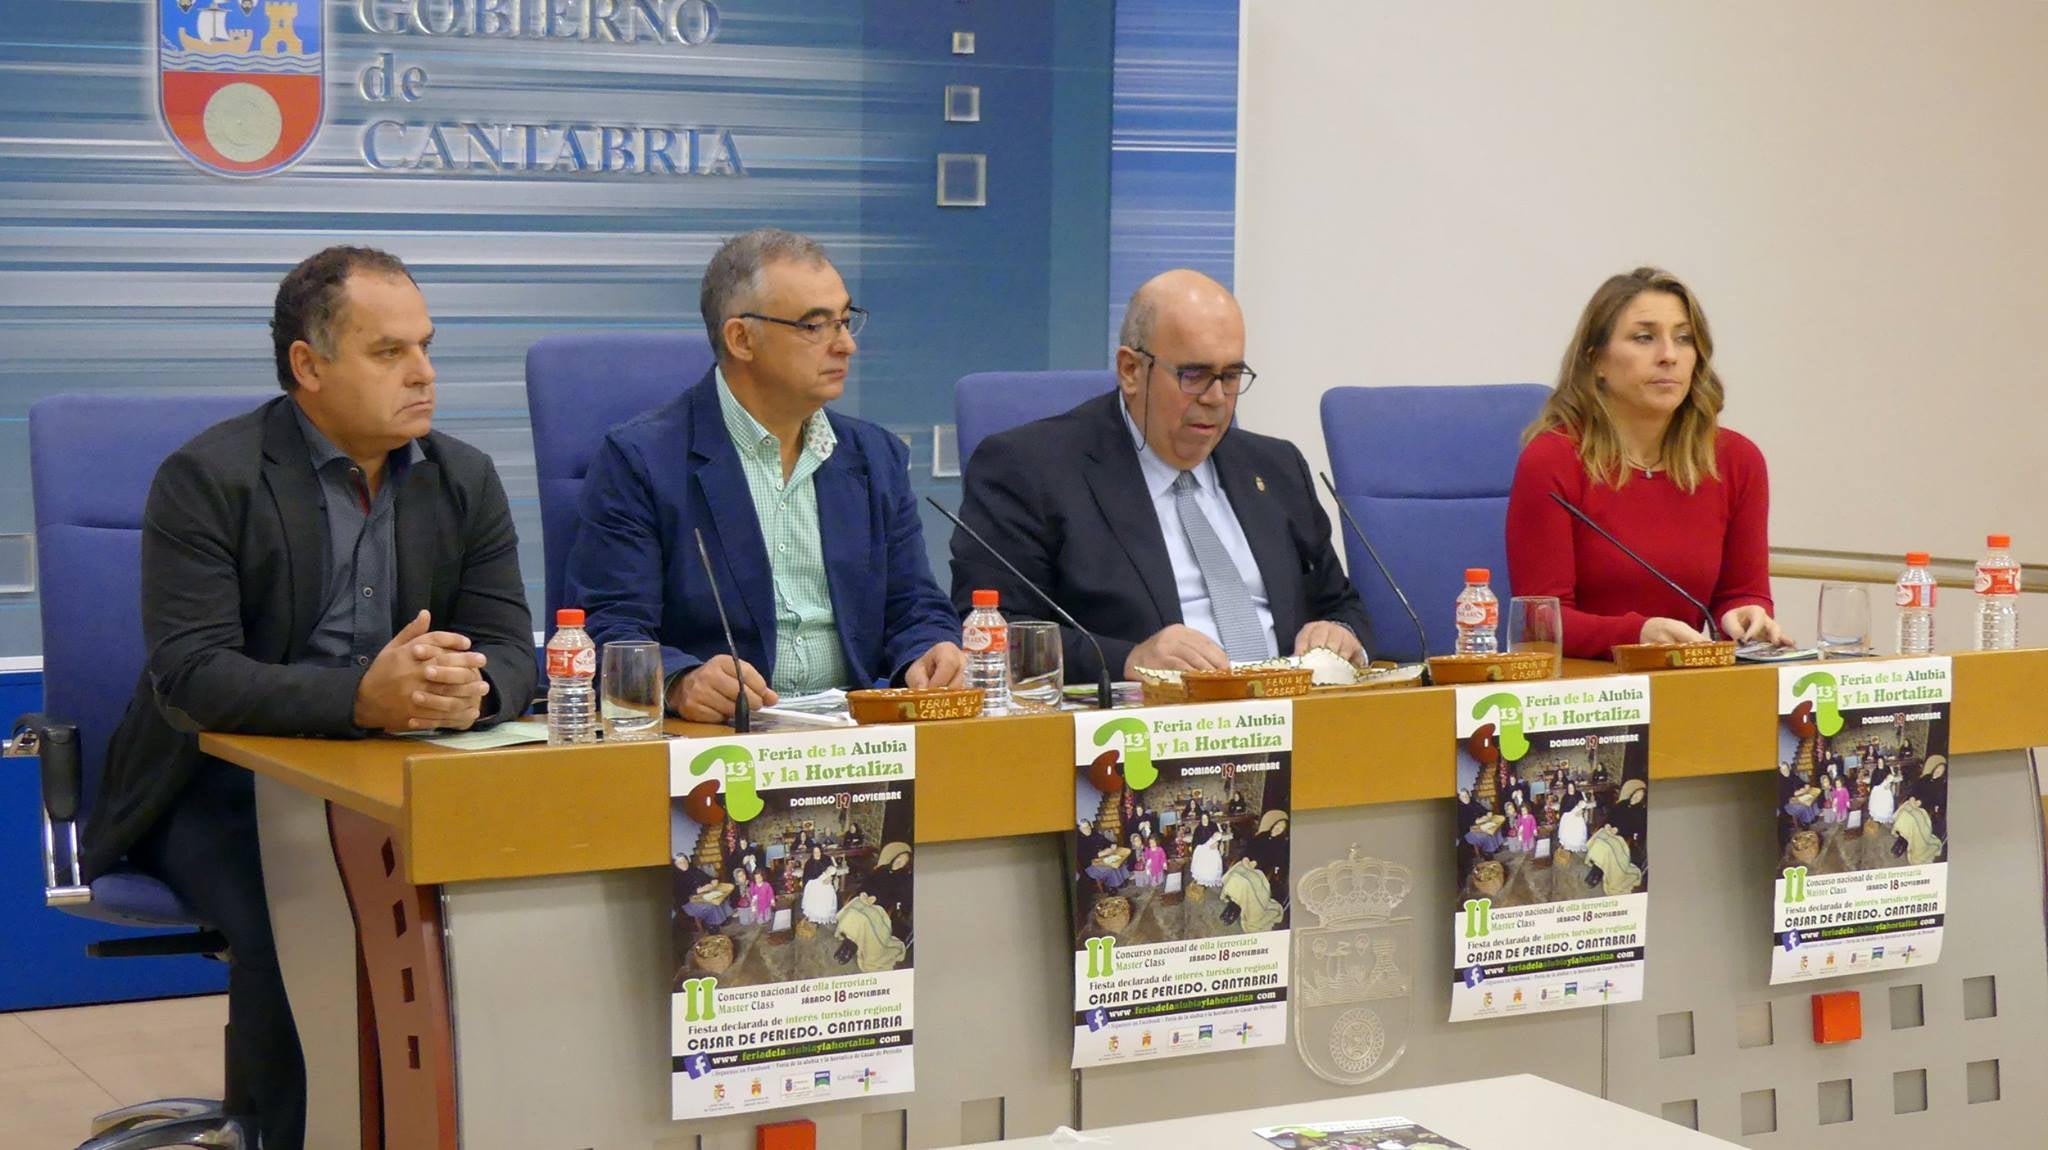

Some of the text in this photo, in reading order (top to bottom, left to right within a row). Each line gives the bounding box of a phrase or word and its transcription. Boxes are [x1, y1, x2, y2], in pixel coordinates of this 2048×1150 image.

[358, 0, 720, 46] GOBIERNO
[359, 52, 429, 102] de
[361, 119, 748, 178] CANTABRIA
[1684, 657, 1718, 666] CASAR
[1840, 668, 1945, 685] Feria de la Alubia
[1265, 687, 1296, 696] CASAR
[1525, 688, 1642, 707] Feria de la Alubia
[1842, 685, 1942, 706] y la Hortaliza
[920, 698, 950, 710] FERIA
[920, 708, 960, 719] CASAR
[1528, 705, 1640, 729] y la Hortaliza
[1153, 713, 1284, 733] Feria de la Alubia
[1156, 731, 1282, 756] y la Hortaliza
[1550, 737, 1585, 748] DOMINGO
[1599, 733, 1638, 744] NOVIEMBRE
[758, 739, 906, 761] Feria de la Alubia
[762, 759, 903, 786] y la Hortaliza
[1181, 765, 1221, 776] DOMINGO
[1236, 761, 1280, 772] NOVIEMBRE
[790, 790, 901, 808] DOMINGO 19 NOVIEMBRE
[1807, 877, 1836, 887] Concurso
[1838, 874, 1864, 884] nacional
[1890, 879, 1899, 890] 18
[1830, 886, 1847, 895] Class
[1491, 909, 1523, 920] Concurso
[1525, 906, 1554, 916] nacional
[1784, 915, 1817, 927] CASAR
[1820, 913, 1833, 923] DE
[1883, 901, 1937, 917] CANTABRIA
[1785, 905, 1806, 914] Fiesta
[1809, 901, 1842, 912] declarada
[1844, 900, 1852, 908] de
[1491, 918, 1535, 931] Master Class
[1583, 910, 1592, 922] 18
[1467, 939, 1490, 949] Fiesta
[1493, 934, 1529, 946] declarada
[1532, 933, 1541, 942] de
[1605, 922, 1636, 934] regional
[1116, 947, 1151, 959] Concurso
[1153, 944, 1186, 955] nacional
[1189, 943, 1197, 951] de
[1199, 940, 1214, 949] olla
[1219, 948, 1229, 961] 18
[1231, 947, 1268, 957] NOVIEMBRE
[1466, 949, 1502, 962] CASAR
[1506, 947, 1519, 958] DE
[1576, 932, 1636, 950] CANTABRIA
[1116, 957, 1165, 971] Master Class
[1089, 979, 1114, 990] Fiesta
[1118, 974, 1159, 987] declarada
[1162, 973, 1171, 982] de
[1244, 961, 1278, 973] regional
[718, 976, 877, 1001] Concurso nacional de olla ferroviaria
[834, 989, 846, 1002] 18
[848, 988, 890, 999] NOVIEMBRE
[1088, 990, 1128, 1004] CASAR
[1133, 988, 1148, 1000] DE
[1211, 972, 1278, 991] CANTABRIA
[1257, 991, 1275, 1000] com
[718, 999, 774, 1014] Master Class
[688, 1023, 717, 1035] Fiesta
[721, 1018, 767, 1032] declarada
[771, 1016, 782, 1026] de
[863, 1002, 901, 1016] regional
[687, 1035, 733, 1050] CASAR
[739, 1032, 755, 1045] DE
[827, 1014, 901, 1035] CANTABRIA
[879, 1034, 899, 1043] com
